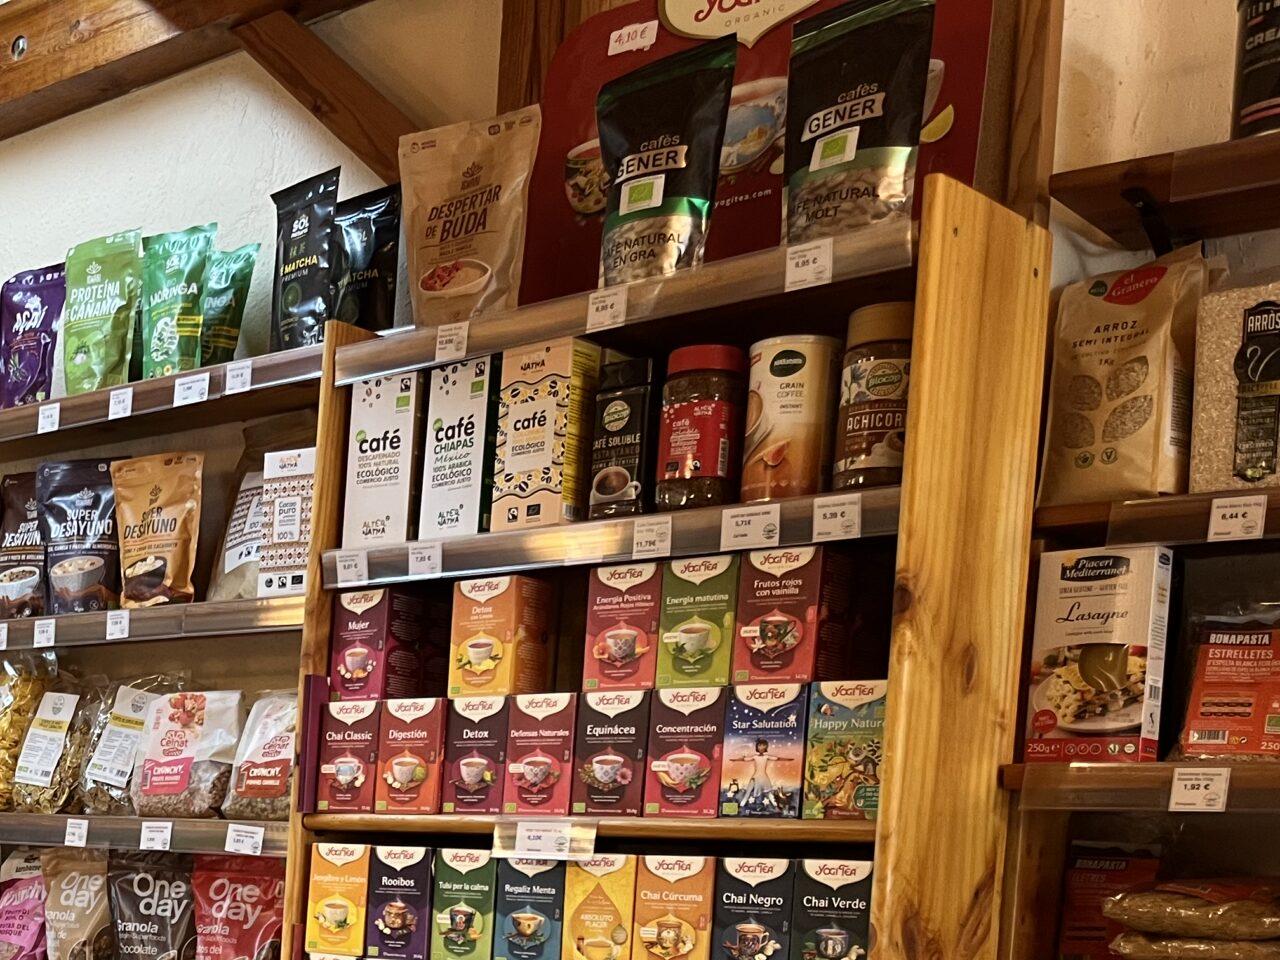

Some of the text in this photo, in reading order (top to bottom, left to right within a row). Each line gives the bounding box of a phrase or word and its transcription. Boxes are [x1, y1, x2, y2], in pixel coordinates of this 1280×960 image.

[724, 5, 786, 28] ORGANIC
[838, 82, 878, 103] cafès
[808, 98, 875, 134] GENER
[640, 133, 680, 151] cafès
[618, 149, 678, 179] GENER
[428, 184, 502, 222] DESPERTAR
[806, 205, 839, 223] MOLT
[292, 216, 310, 230] SOL
[426, 212, 488, 243] DE BUDA
[284, 254, 318, 274] MATCHA
[614, 256, 627, 268] EN
[1112, 276, 1159, 297] Granero
[1124, 274, 1133, 285] el
[70, 280, 120, 302] PROTEÍNA
[150, 282, 198, 306] MORINGA
[1094, 320, 1138, 334] ARROZ
[1072, 330, 1149, 349] SEMI INTEGRAL
[780, 381, 804, 390] GRAIN
[777, 390, 804, 398] COFFEE
[513, 410, 547, 431] café
[435, 414, 475, 442] café
[359, 429, 401, 454] café
[434, 437, 474, 455] CHIAPAS
[512, 440, 545, 451] ECOLÓGICO
[434, 451, 470, 465] México
[357, 466, 400, 479] ECOLÓGICO
[432, 468, 472, 482] ECOLÓGICO
[67, 509, 97, 522] SUPER
[1221, 512, 1238, 521] 6,44
[51, 518, 112, 538] DESAYUNO
[124, 518, 177, 540] DESAYUNO
[1078, 558, 1113, 569] Piaceri
[754, 578, 802, 588] Frutos rojos
[695, 593, 728, 603] matutina
[756, 586, 799, 596] con vainilla
[1055, 602, 1128, 625] Lasagne
[348, 620, 370, 631] Mujer
[1209, 633, 1270, 645] BONAPASTA
[1209, 649, 1273, 659] ESTRELLETES
[586, 724, 636, 735] Equinácea
[656, 724, 716, 734] Concentración
[733, 718, 797, 729] Star Salutation
[326, 730, 372, 741] Chai Classic
[389, 729, 427, 740] Digestión
[463, 729, 488, 739] Detox
[511, 729, 569, 738] Defensas Naturales
[160, 737, 189, 749] Celnat
[1028, 743, 1050, 753] 250g
[61, 872, 104, 893] One
[133, 873, 187, 899] One
[382, 876, 415, 887] Rooibos
[209, 878, 261, 903] One
[505, 884, 555, 894] Regaliz Menta
[641, 890, 703, 902] Chai Cúrcuma
[61, 886, 102, 914] day
[723, 892, 783, 906] Chai Negro
[803, 896, 866, 909] Chai Verde
[138, 897, 188, 922] day
[212, 898, 263, 929] day
